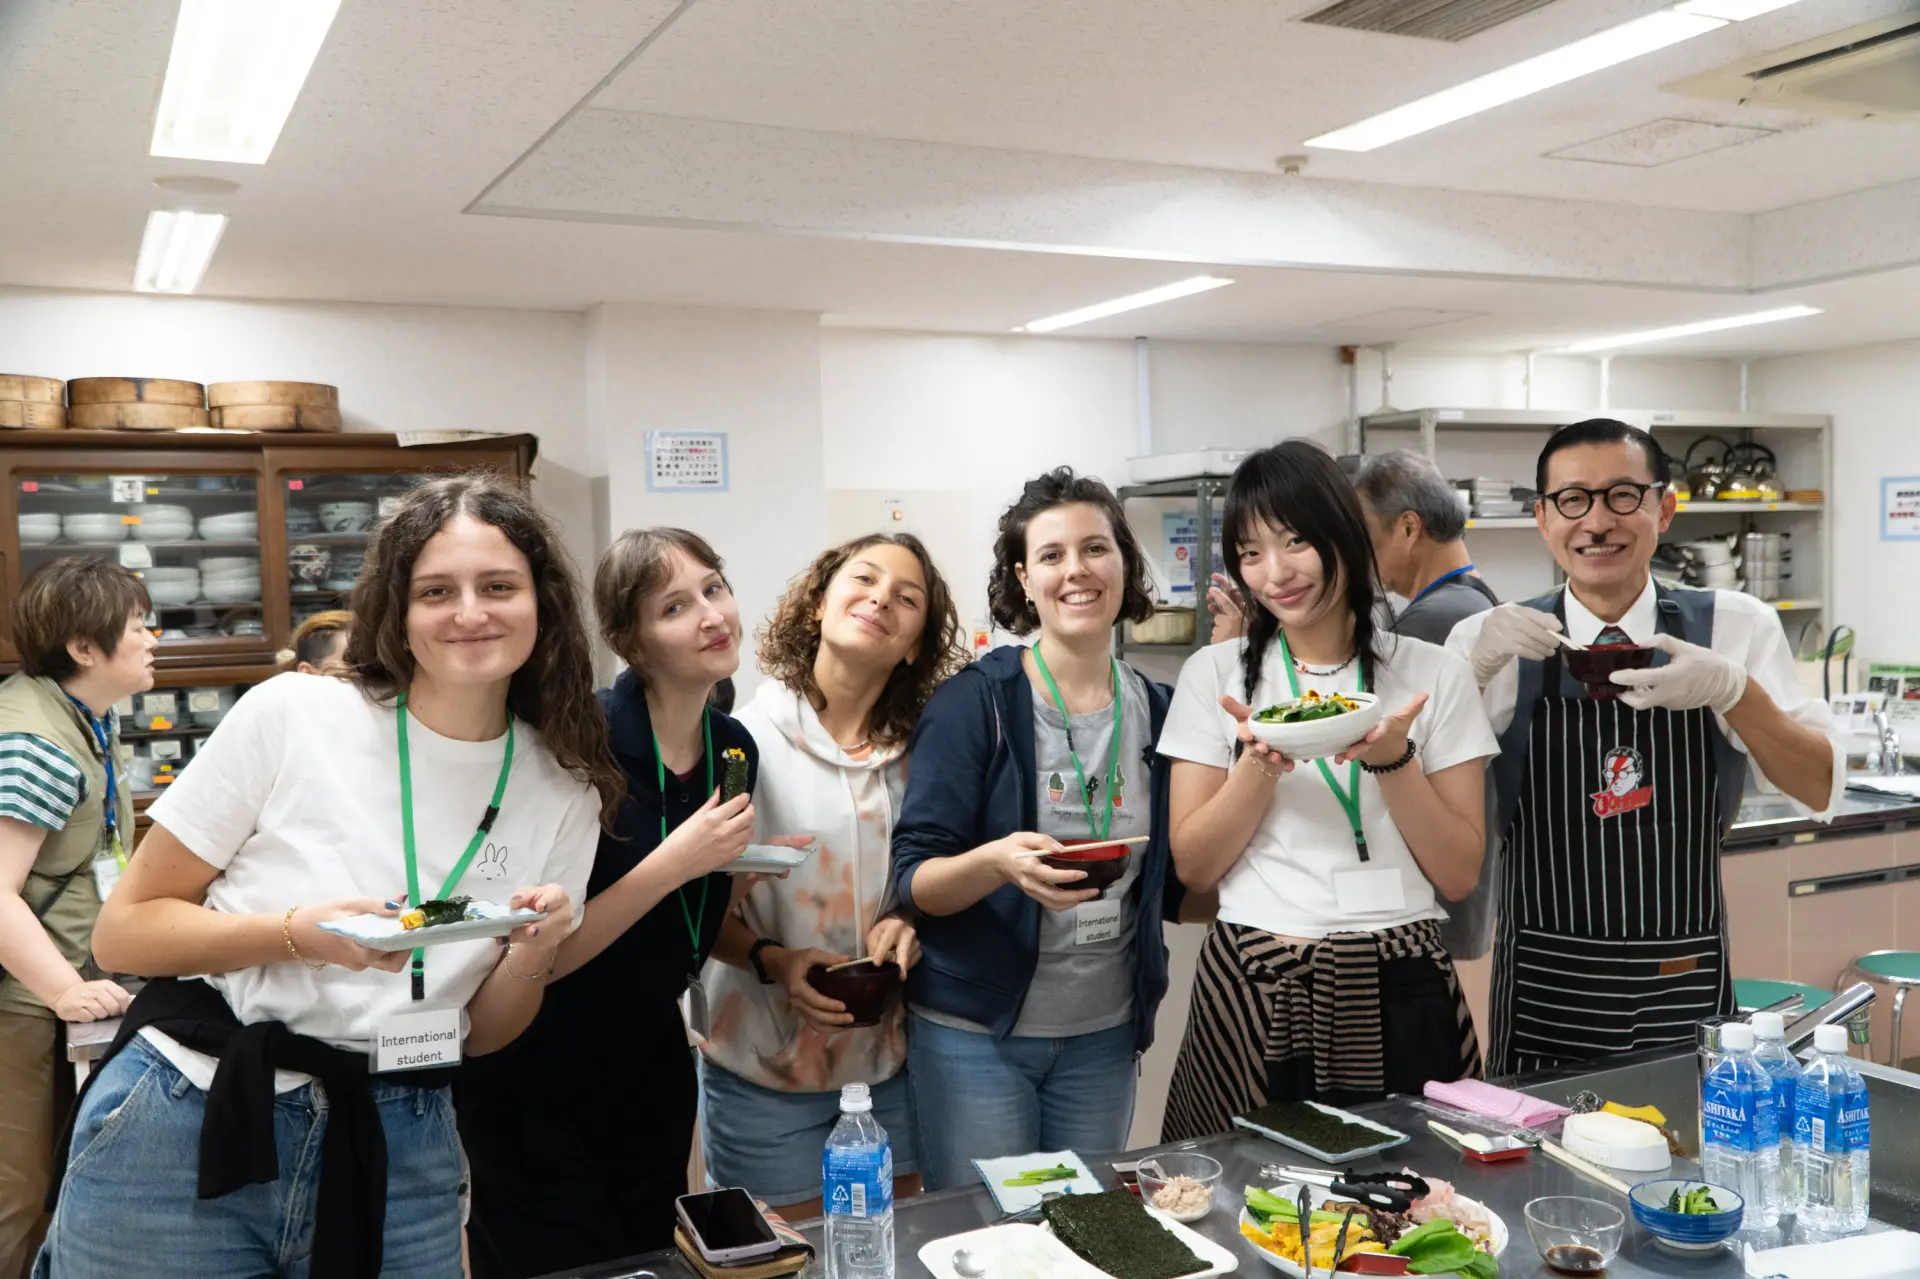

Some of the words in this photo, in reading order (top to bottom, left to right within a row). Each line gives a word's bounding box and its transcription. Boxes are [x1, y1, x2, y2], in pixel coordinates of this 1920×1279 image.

[1078, 911, 1119, 928] International
[1086, 930, 1111, 942] student
[381, 1028, 456, 1047] International
[397, 1050, 443, 1065] student
